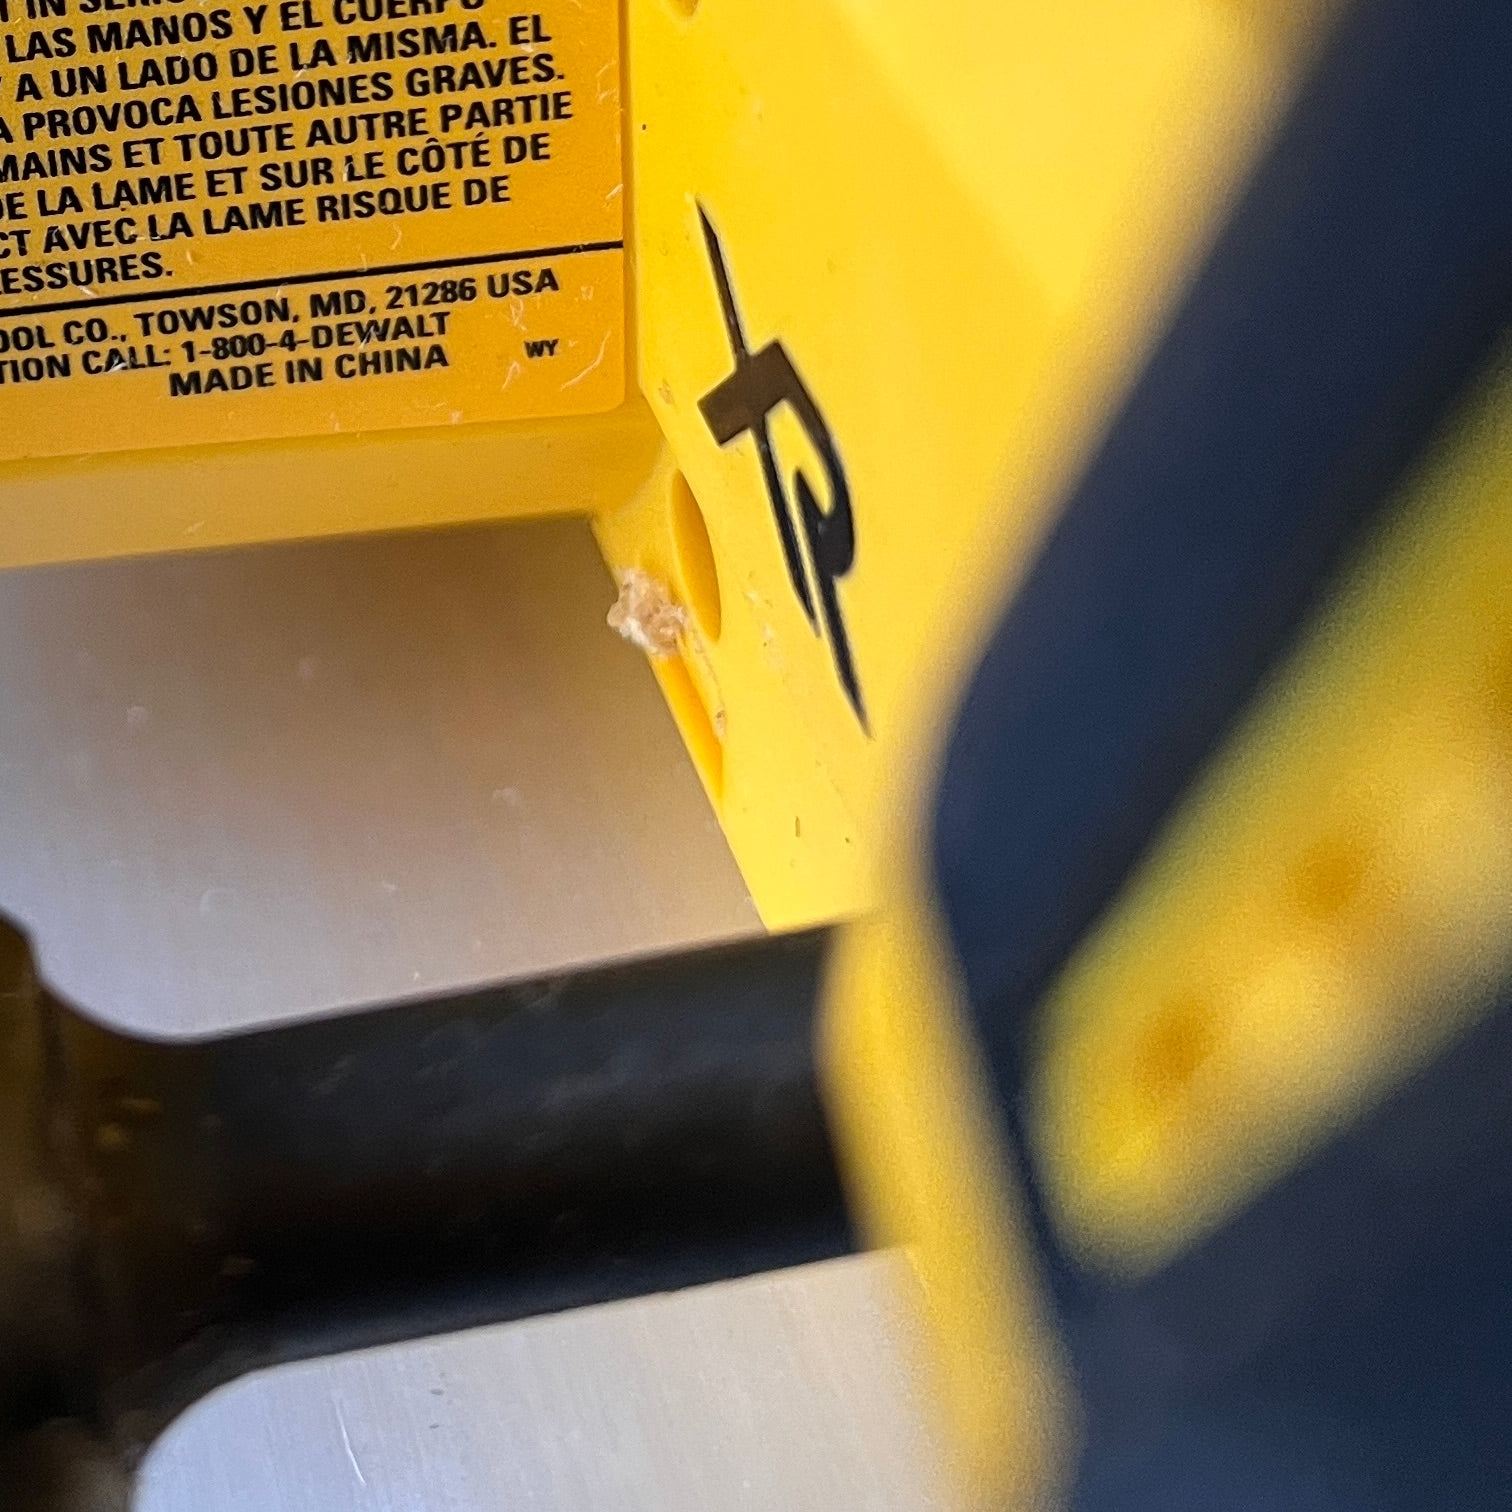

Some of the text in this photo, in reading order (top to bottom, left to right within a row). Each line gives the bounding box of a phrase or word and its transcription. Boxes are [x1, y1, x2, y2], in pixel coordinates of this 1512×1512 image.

[4, 27, 77, 64] LAS
[86, 8, 234, 54] MANOS
[242, 4, 269, 35] Y
[279, 0, 324, 32] EL
[15, 72, 44, 103] A
[49, 64, 108, 98] UN
[117, 51, 219, 91] LADO
[229, 44, 280, 78] DE
[289, 38, 338, 72] LA
[346, 21, 497, 65] MISMA.
[508, 14, 553, 46] EL
[22, 94, 203, 142] PROVOCA
[211, 71, 394, 120] LESIONES
[405, 52, 565, 98] GRAVES.
[122, 137, 166, 169] ET
[172, 122, 296, 162] TOUTE
[305, 107, 430, 148] AUTRE
[439, 90, 574, 134] PARTIE
[36, 185, 84, 217] LA
[91, 172, 197, 211] LAME
[205, 166, 249, 198] ET
[259, 157, 335, 192] SUR
[344, 151, 387, 183] LE
[396, 131, 492, 177] CÔTÉ
[502, 132, 551, 165] DE
[43, 217, 139, 254] AVEC
[147, 211, 195, 242] LA
[202, 198, 307, 235] LAME
[316, 181, 453, 223] RISQUE
[463, 175, 511, 206] DE
[62, 317, 127, 346] CO.,
[133, 297, 300, 337] TOWSON,
[309, 289, 377, 319] MD,
[385, 277, 478, 310] 21286
[487, 267, 560, 299] USA
[180, 311, 451, 363] 1-800-4-DEWALT
[168, 343, 450, 397] MADE IN CHINA
[524, 338, 559, 359] WY
